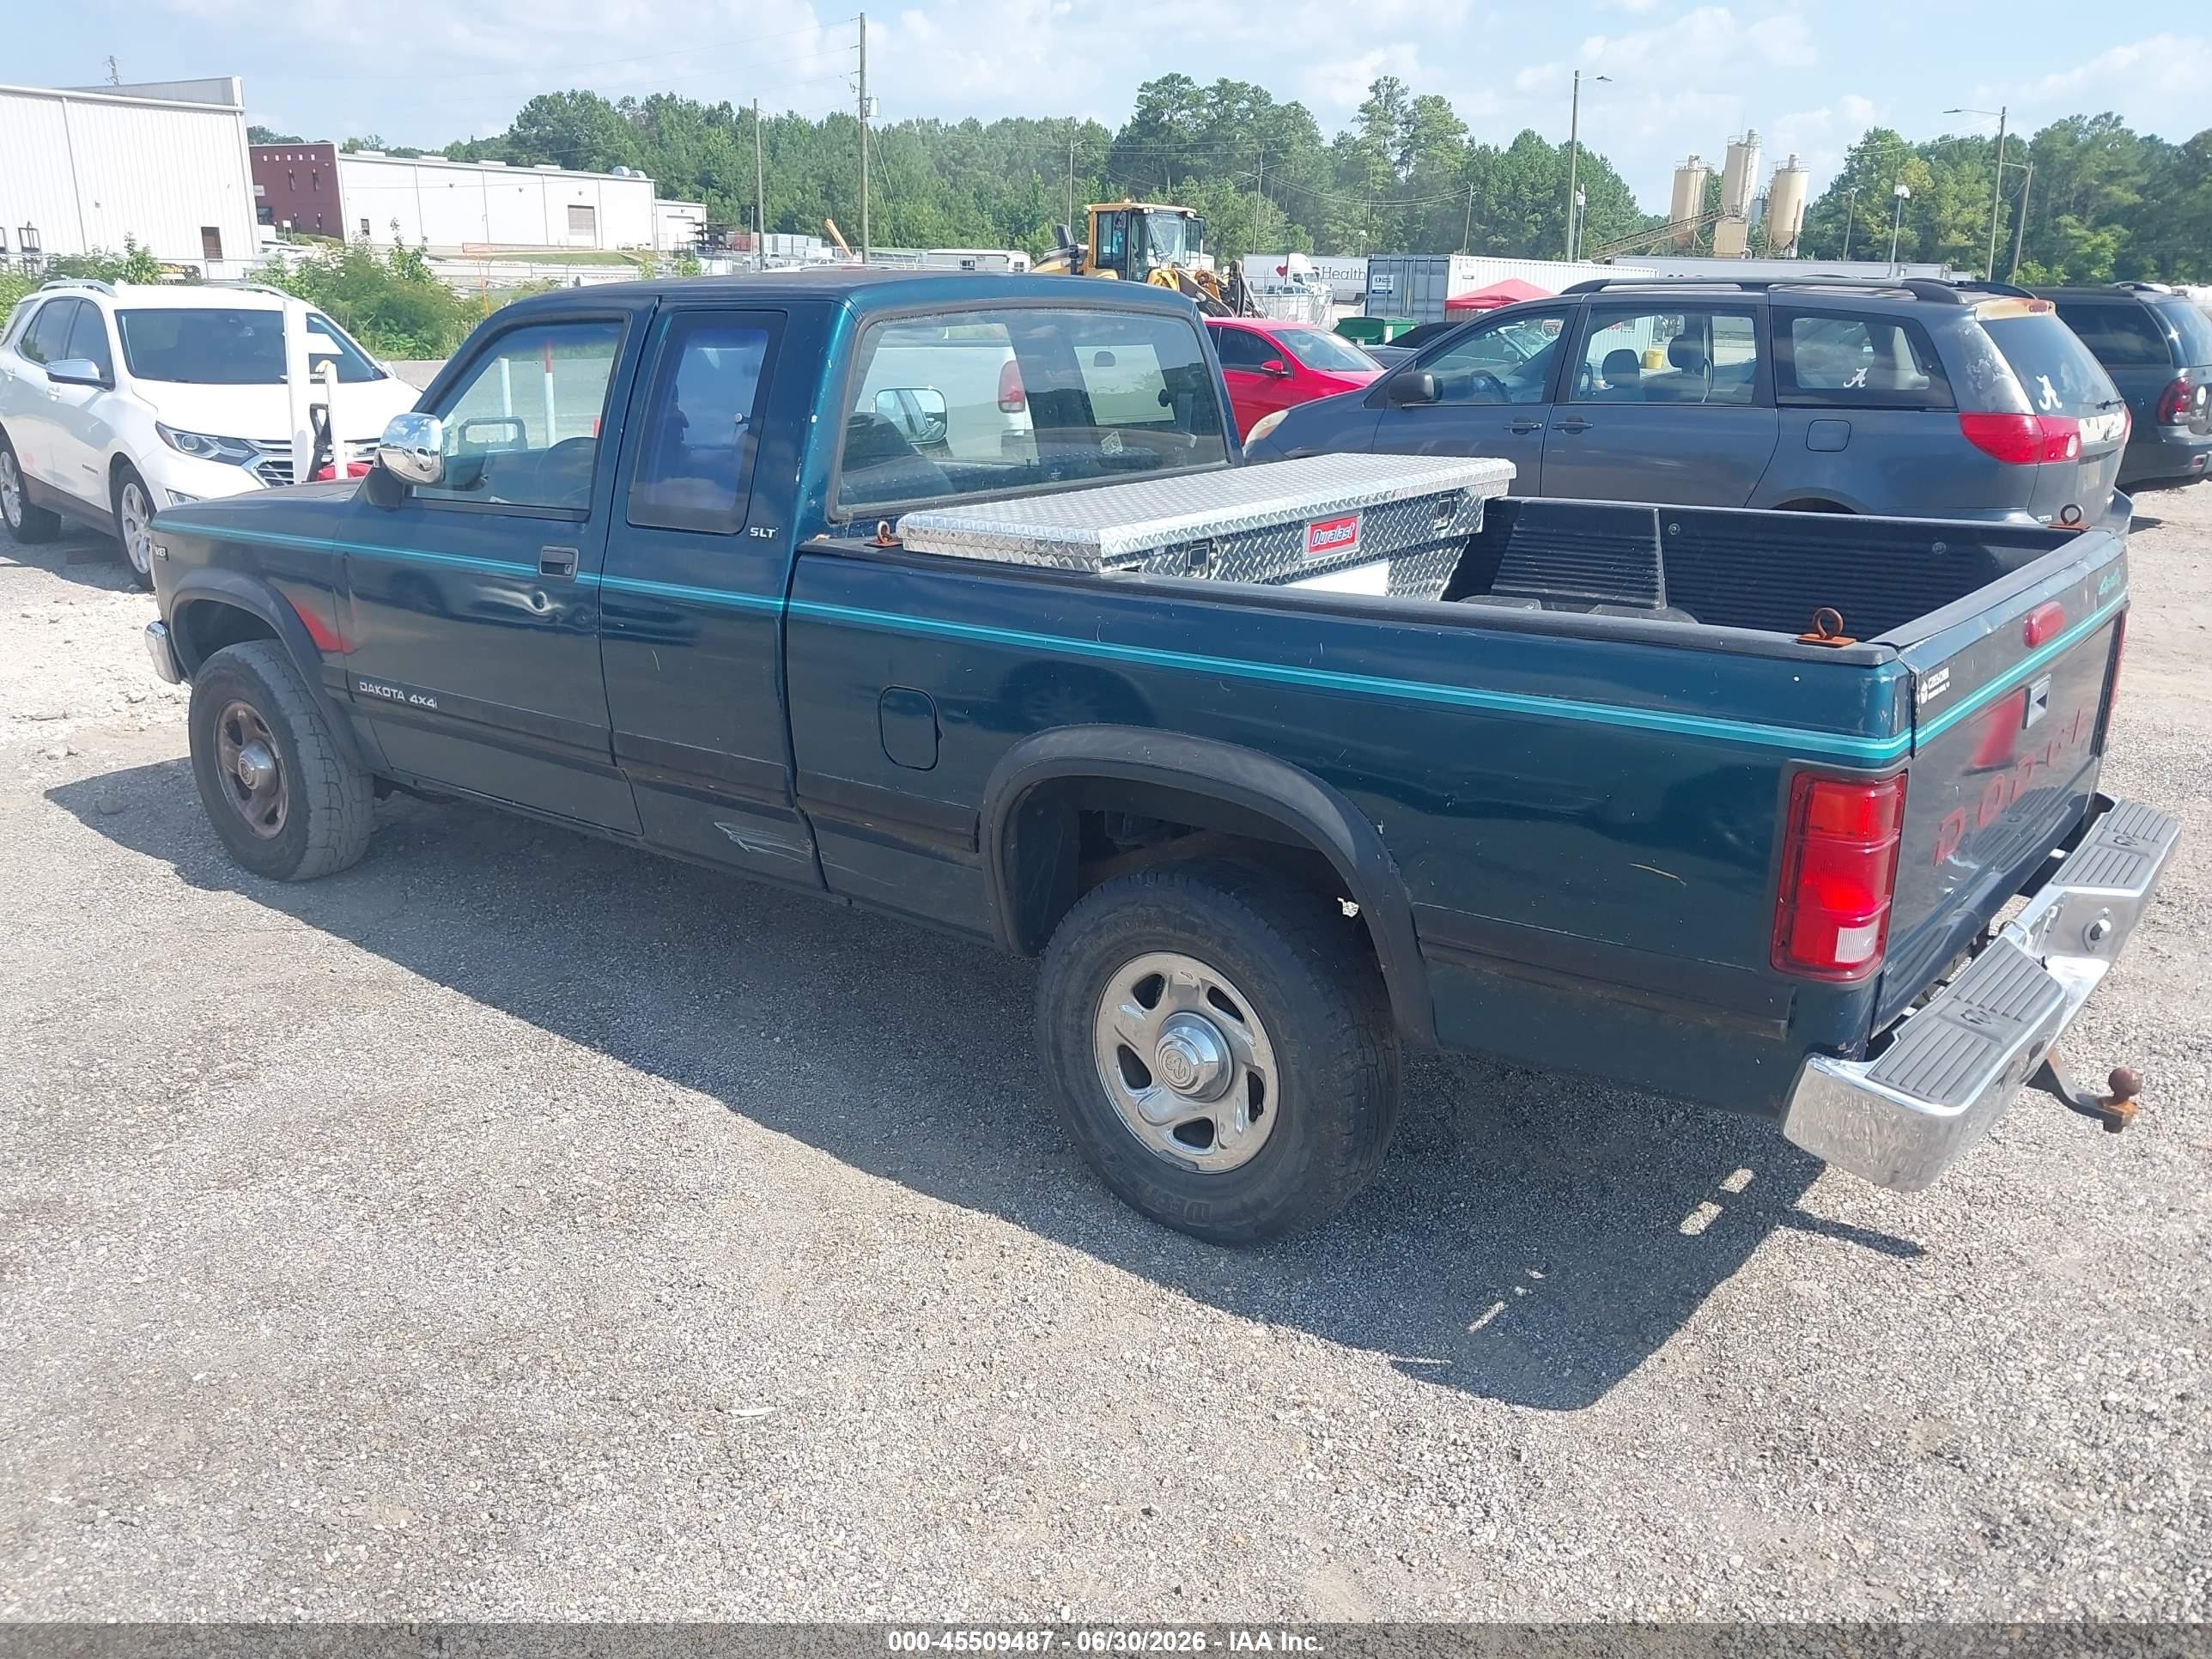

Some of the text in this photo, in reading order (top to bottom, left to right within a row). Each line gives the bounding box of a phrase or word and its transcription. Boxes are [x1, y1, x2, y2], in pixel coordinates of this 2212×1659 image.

[1322, 266, 1367, 281] Health
[750, 527, 776, 538] SLT
[1311, 522, 1356, 546] Duralast
[359, 681, 405, 702] DAKOTA
